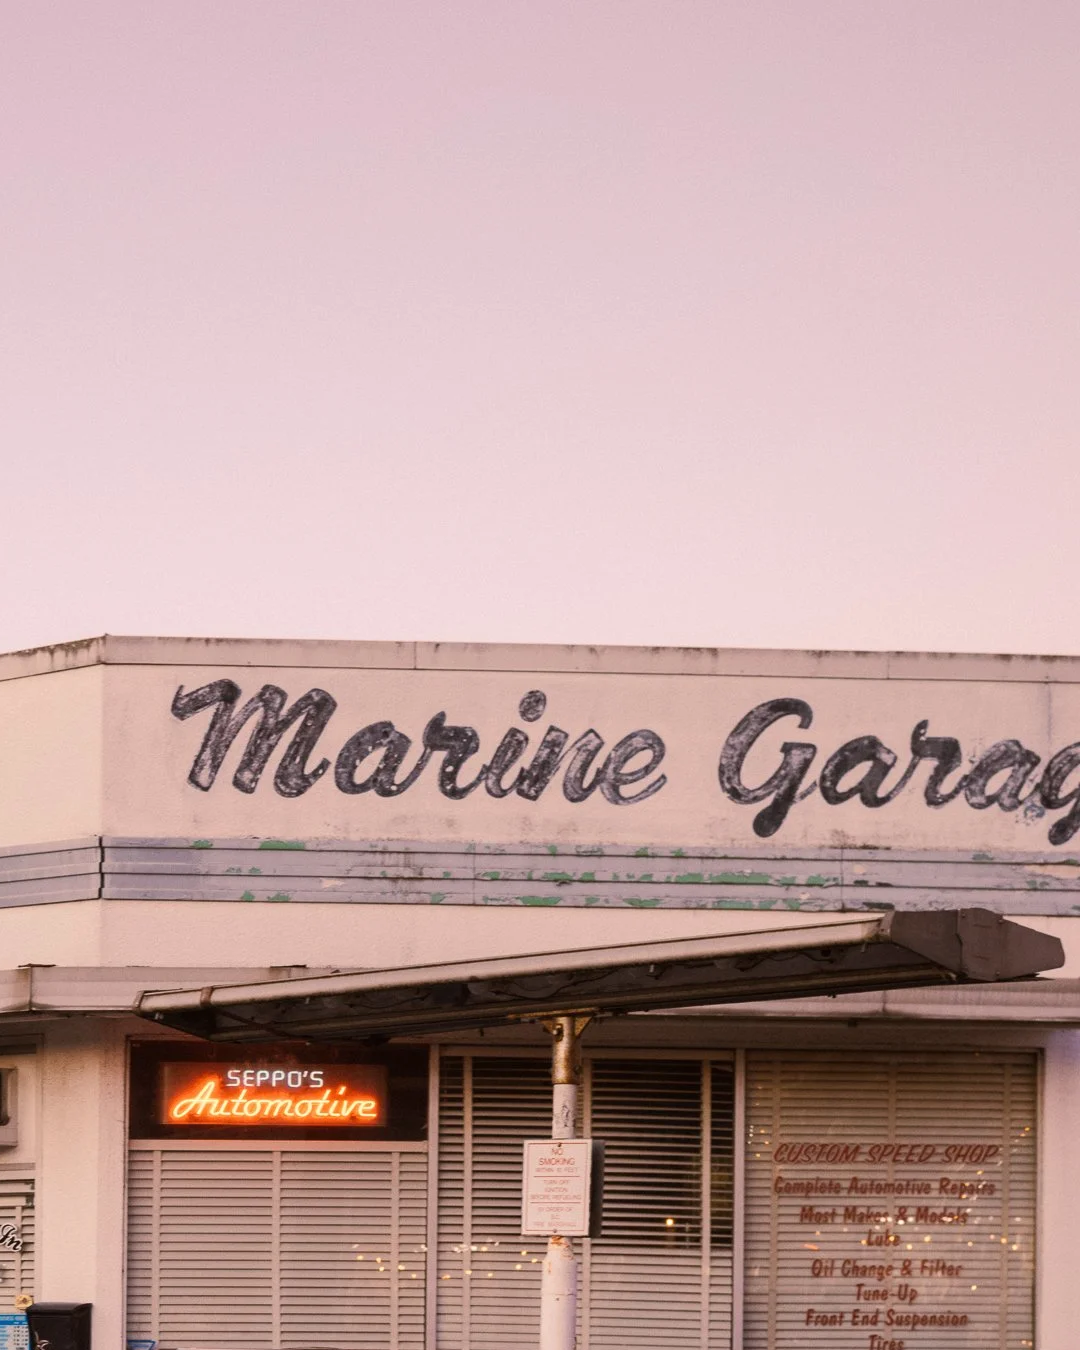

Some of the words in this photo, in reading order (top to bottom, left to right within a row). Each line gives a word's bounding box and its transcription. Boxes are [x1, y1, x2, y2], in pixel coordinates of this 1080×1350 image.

[171, 678, 667, 806] Marine
[226, 1069, 324, 1088] SEPPO'S
[172, 1080, 377, 1118] Automotive
[539, 1157, 576, 1166] SMOKING
[551, 1148, 564, 1156] NO
[773, 1143, 860, 1164] CUSTOM
[865, 1143, 936, 1164] SPEED
[941, 1143, 1000, 1164] SHOP
[774, 1175, 841, 1198] Complete
[847, 1175, 932, 1196] Automotive
[938, 1176, 995, 1198] Repairs
[800, 1206, 836, 1224] Most
[843, 1206, 889, 1224] Makes
[895, 1206, 908, 1223] &
[915, 1206, 968, 1225] Models
[866, 1230, 901, 1247] Lube
[811, 1258, 837, 1278] Oil
[841, 1258, 894, 1282] Change
[901, 1258, 913, 1277] &
[920, 1258, 963, 1277] Filter
[855, 1283, 918, 1305] Tune-Up
[805, 1309, 845, 1326] Front
[851, 1309, 879, 1327] End
[884, 1309, 969, 1331] Suspension
